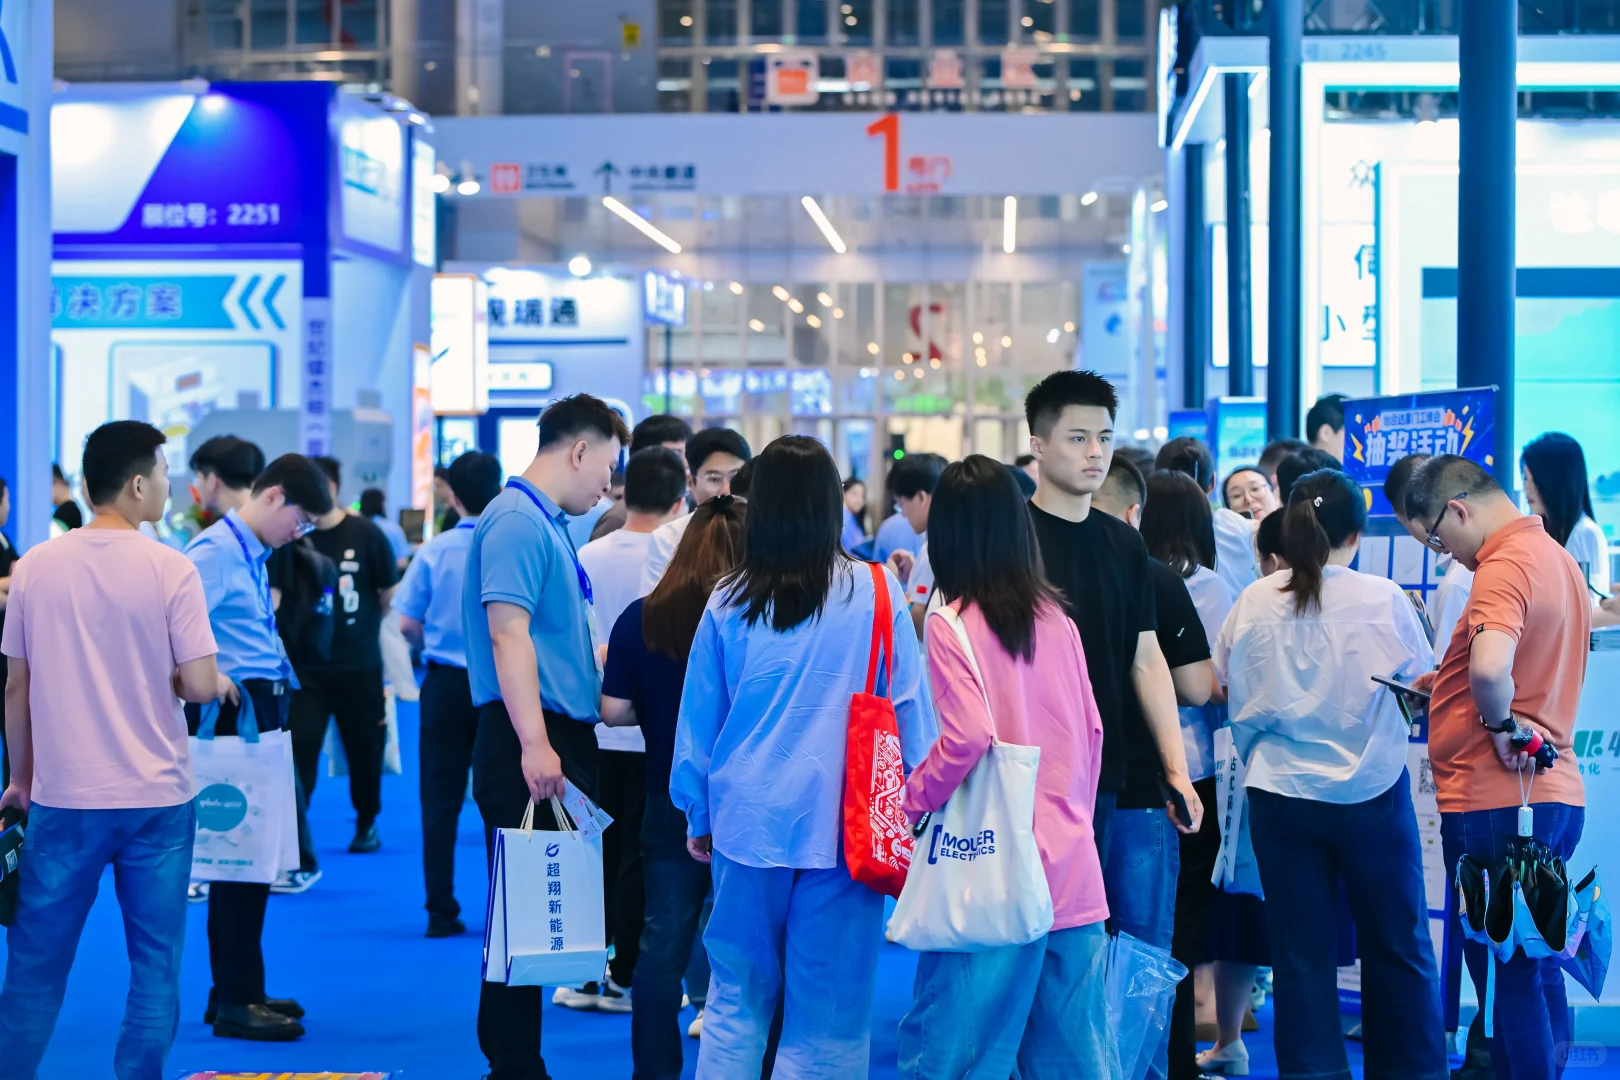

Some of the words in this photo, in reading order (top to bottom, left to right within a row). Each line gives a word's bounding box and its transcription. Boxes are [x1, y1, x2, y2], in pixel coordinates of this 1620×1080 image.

[866, 112, 899, 191] 1
[1365, 427, 1459, 468] 抽奖活动
[941, 829, 995, 853] MOUER
[546, 862, 565, 951] 超翔新能源
